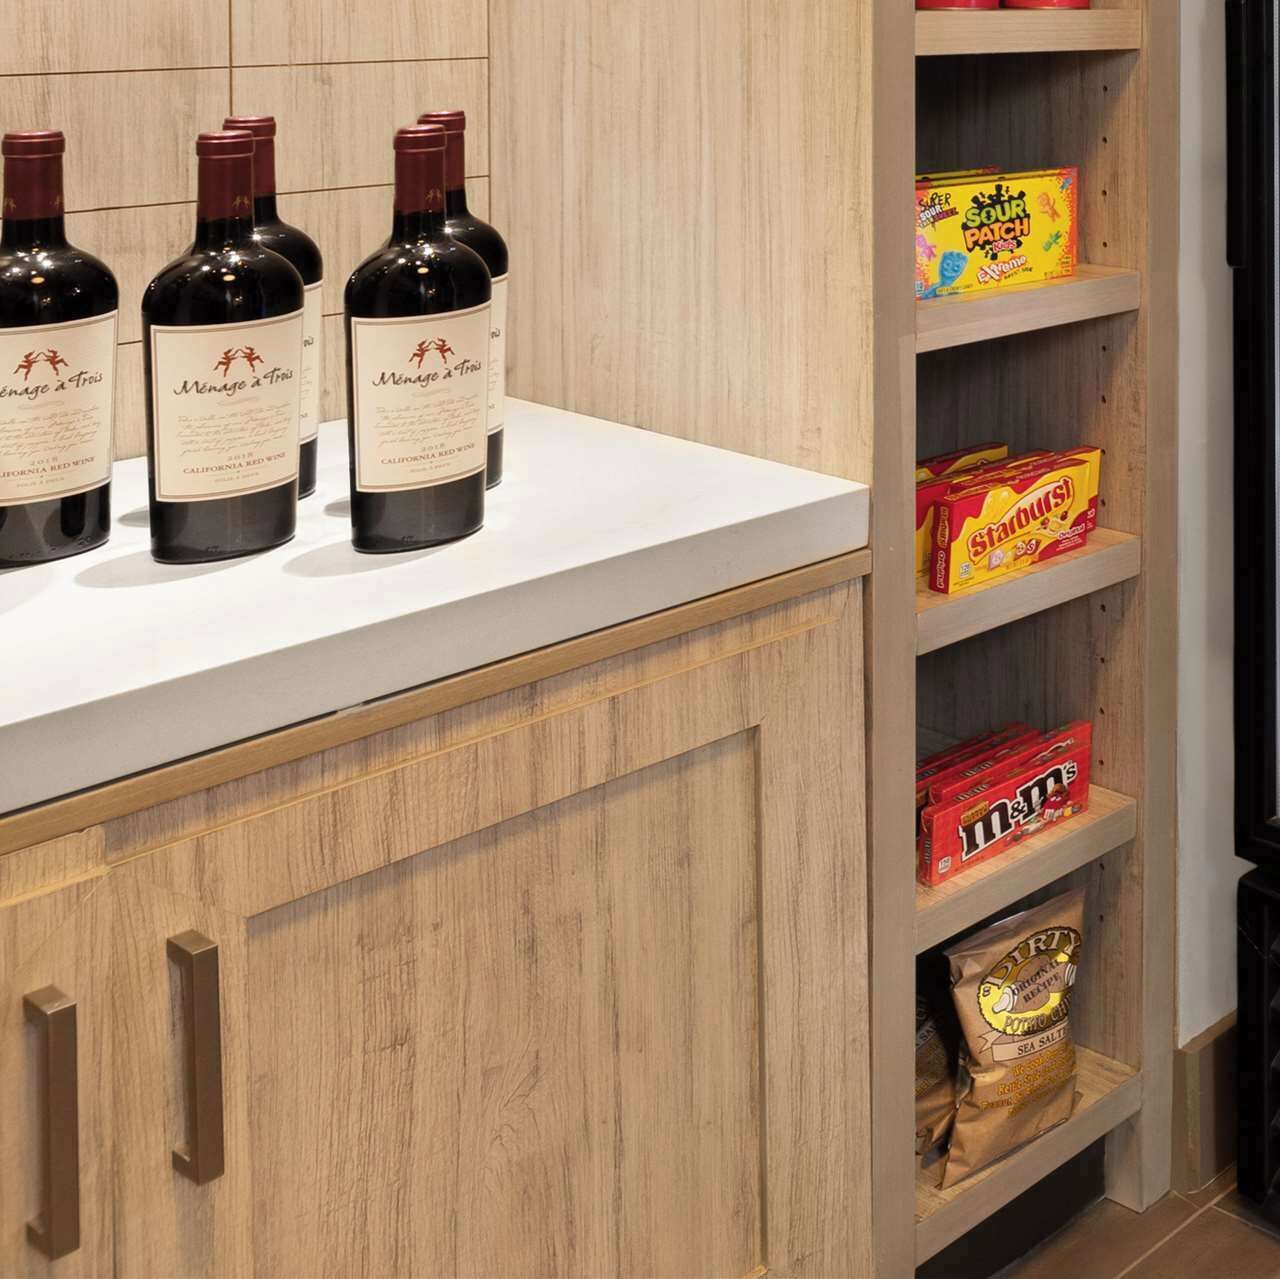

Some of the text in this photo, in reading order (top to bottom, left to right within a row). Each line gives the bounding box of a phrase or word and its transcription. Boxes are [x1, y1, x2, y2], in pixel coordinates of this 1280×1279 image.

[965, 199, 1025, 227] SOUR
[963, 218, 1029, 249] PATCH
[454, 359, 481, 376] Trois
[0, 384, 49, 400] énage
[68, 371, 103, 388] Trois
[173, 379, 246, 396] Ménage
[263, 368, 293, 384] Trois
[184, 452, 286, 474] CALIFORNIA RED WINE
[969, 477, 1072, 557] Starburst
[984, 930, 1080, 985] DIRTY
[1018, 1042, 1035, 1055] SEA
